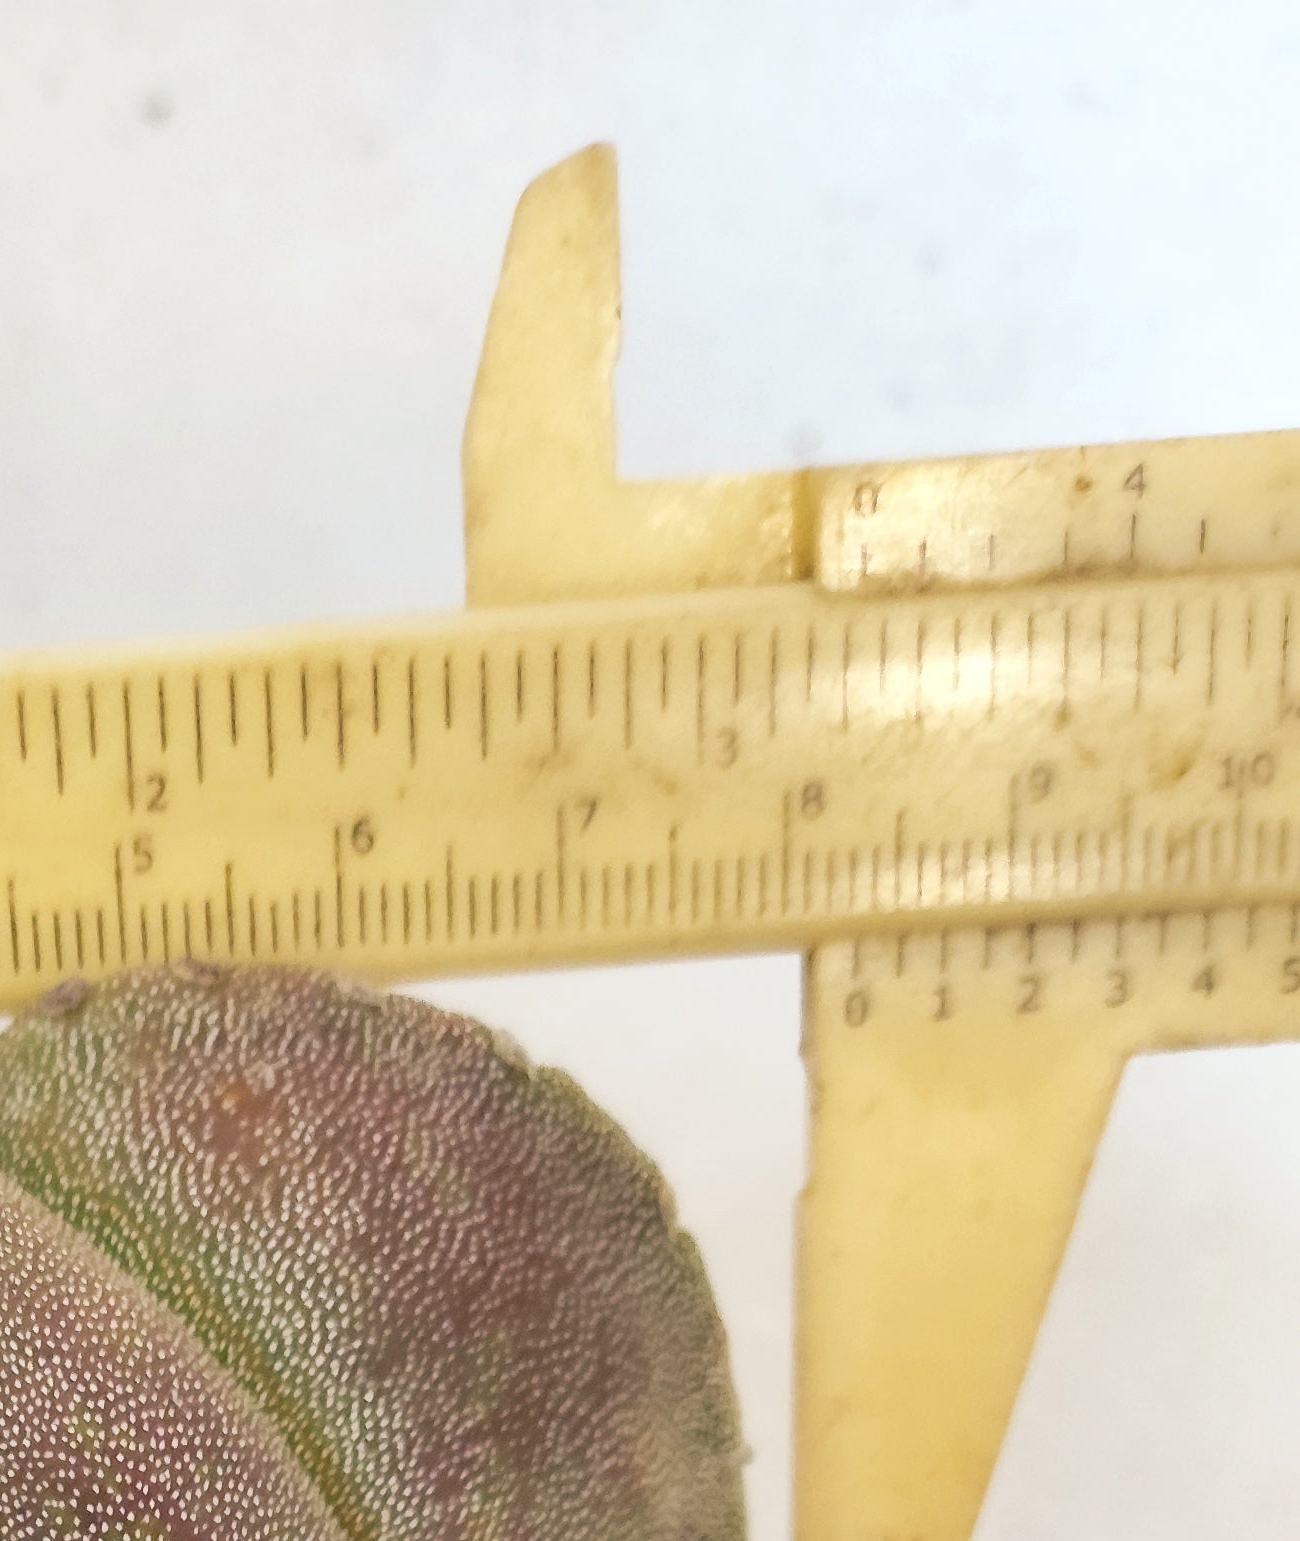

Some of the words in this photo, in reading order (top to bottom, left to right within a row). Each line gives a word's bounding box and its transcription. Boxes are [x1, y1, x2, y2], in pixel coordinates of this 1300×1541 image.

[1124, 462, 1146, 498] 4
[146, 773, 168, 812] 2
[715, 725, 740, 769] 3
[133, 837, 154, 874] 5
[351, 814, 374, 854] 6
[573, 796, 598, 832] 7
[801, 778, 826, 820] 8
[1029, 763, 1055, 800] 9
[844, 990, 870, 1028] 0
[933, 985, 955, 1021] 1
[1016, 976, 1044, 1014] 2
[1105, 969, 1130, 1008] 3
[1191, 965, 1215, 998] 4
[1280, 957, 1300, 995] 5
